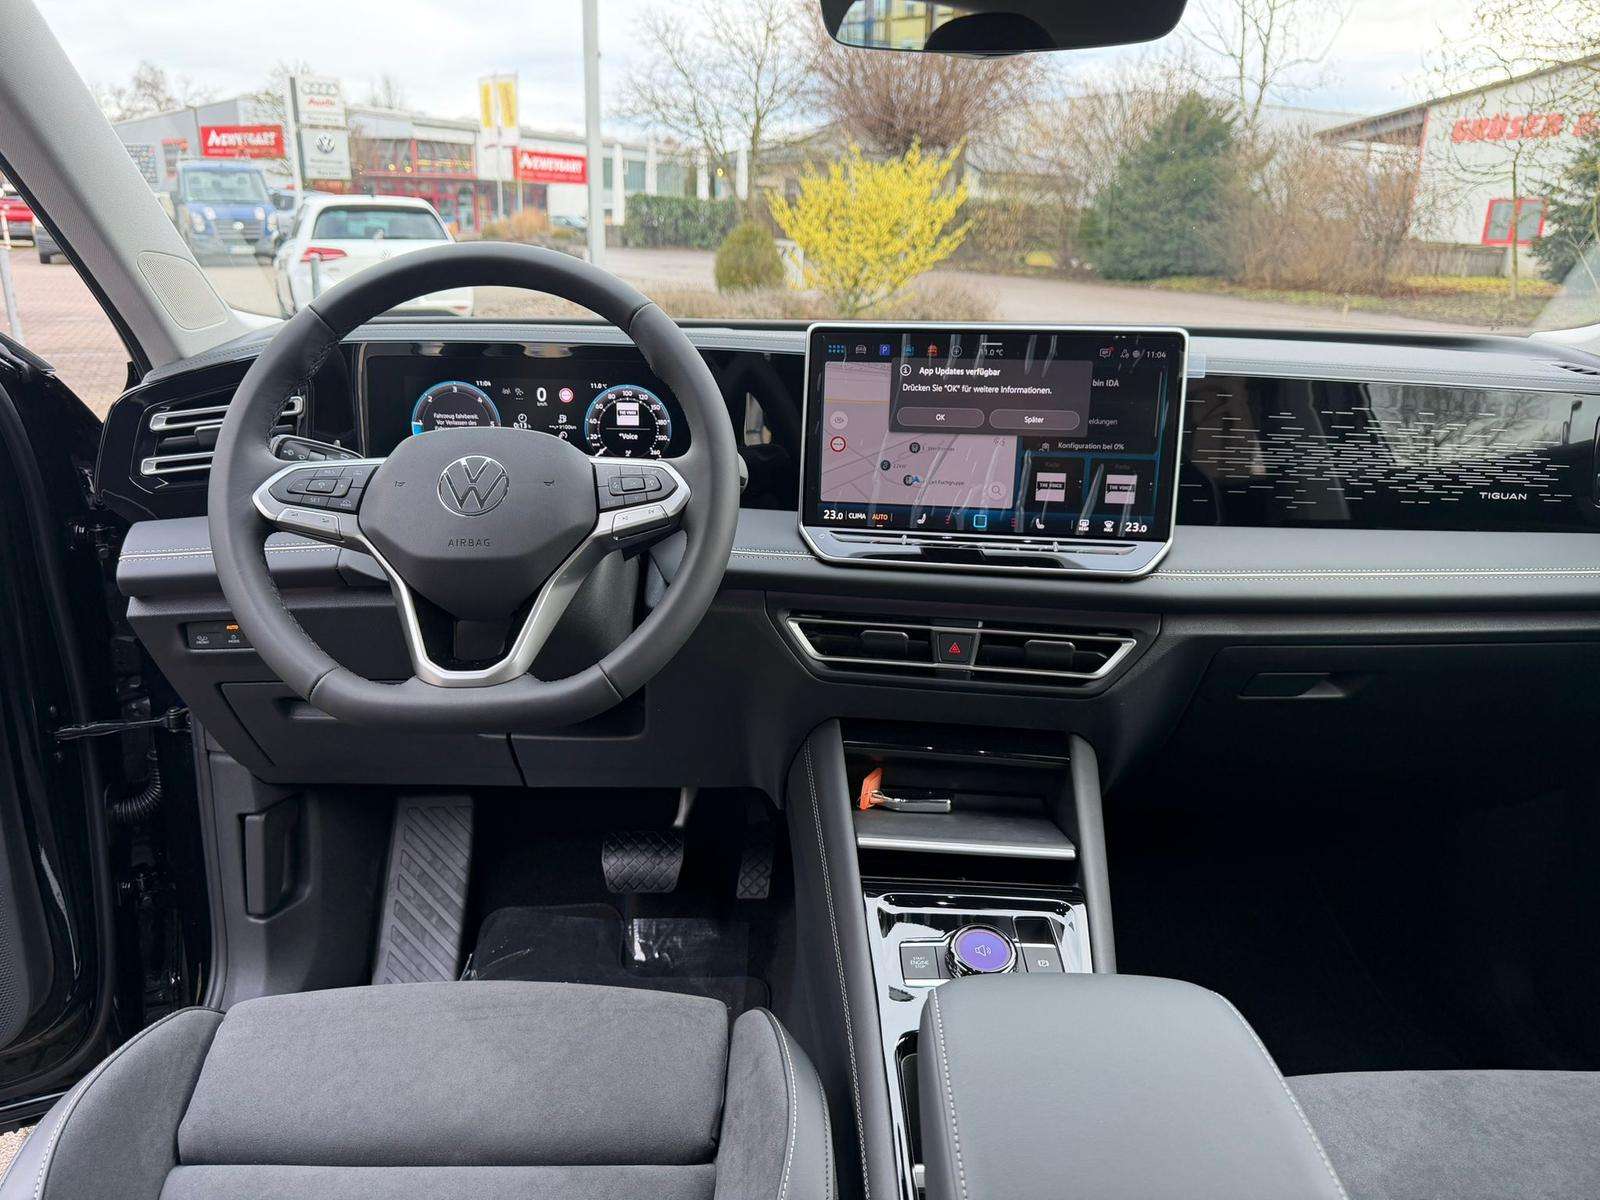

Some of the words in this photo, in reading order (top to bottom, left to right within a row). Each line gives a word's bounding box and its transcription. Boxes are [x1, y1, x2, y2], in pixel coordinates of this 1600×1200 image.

[1147, 351, 1167, 359] 11:04
[918, 367, 934, 377] App
[935, 367, 965, 377] Updates
[965, 367, 1001, 377] verfügbar
[1092, 379, 1105, 388] bin
[1106, 379, 1120, 388] IDA
[902, 383, 931, 392] Drücken
[931, 384, 943, 392] Sie
[961, 385, 972, 393] für
[973, 385, 999, 394] weitere
[1000, 386, 1053, 394] Informationen.
[427, 395, 433, 403] 2
[536, 387, 547, 402] 0
[433, 412, 455, 420] Fahrzeug
[935, 413, 946, 421] OK
[1024, 415, 1045, 424] Später
[1057, 441, 1101, 451] Konfiguration
[1102, 442, 1113, 450] bei
[1479, 491, 1528, 501] TIGUAN
[823, 509, 844, 520] 23.0
[848, 512, 867, 520] CLIMA
[871, 513, 888, 521] AUTO
[1125, 521, 1148, 533] 23.0
[447, 538, 490, 547] AIRBAG
